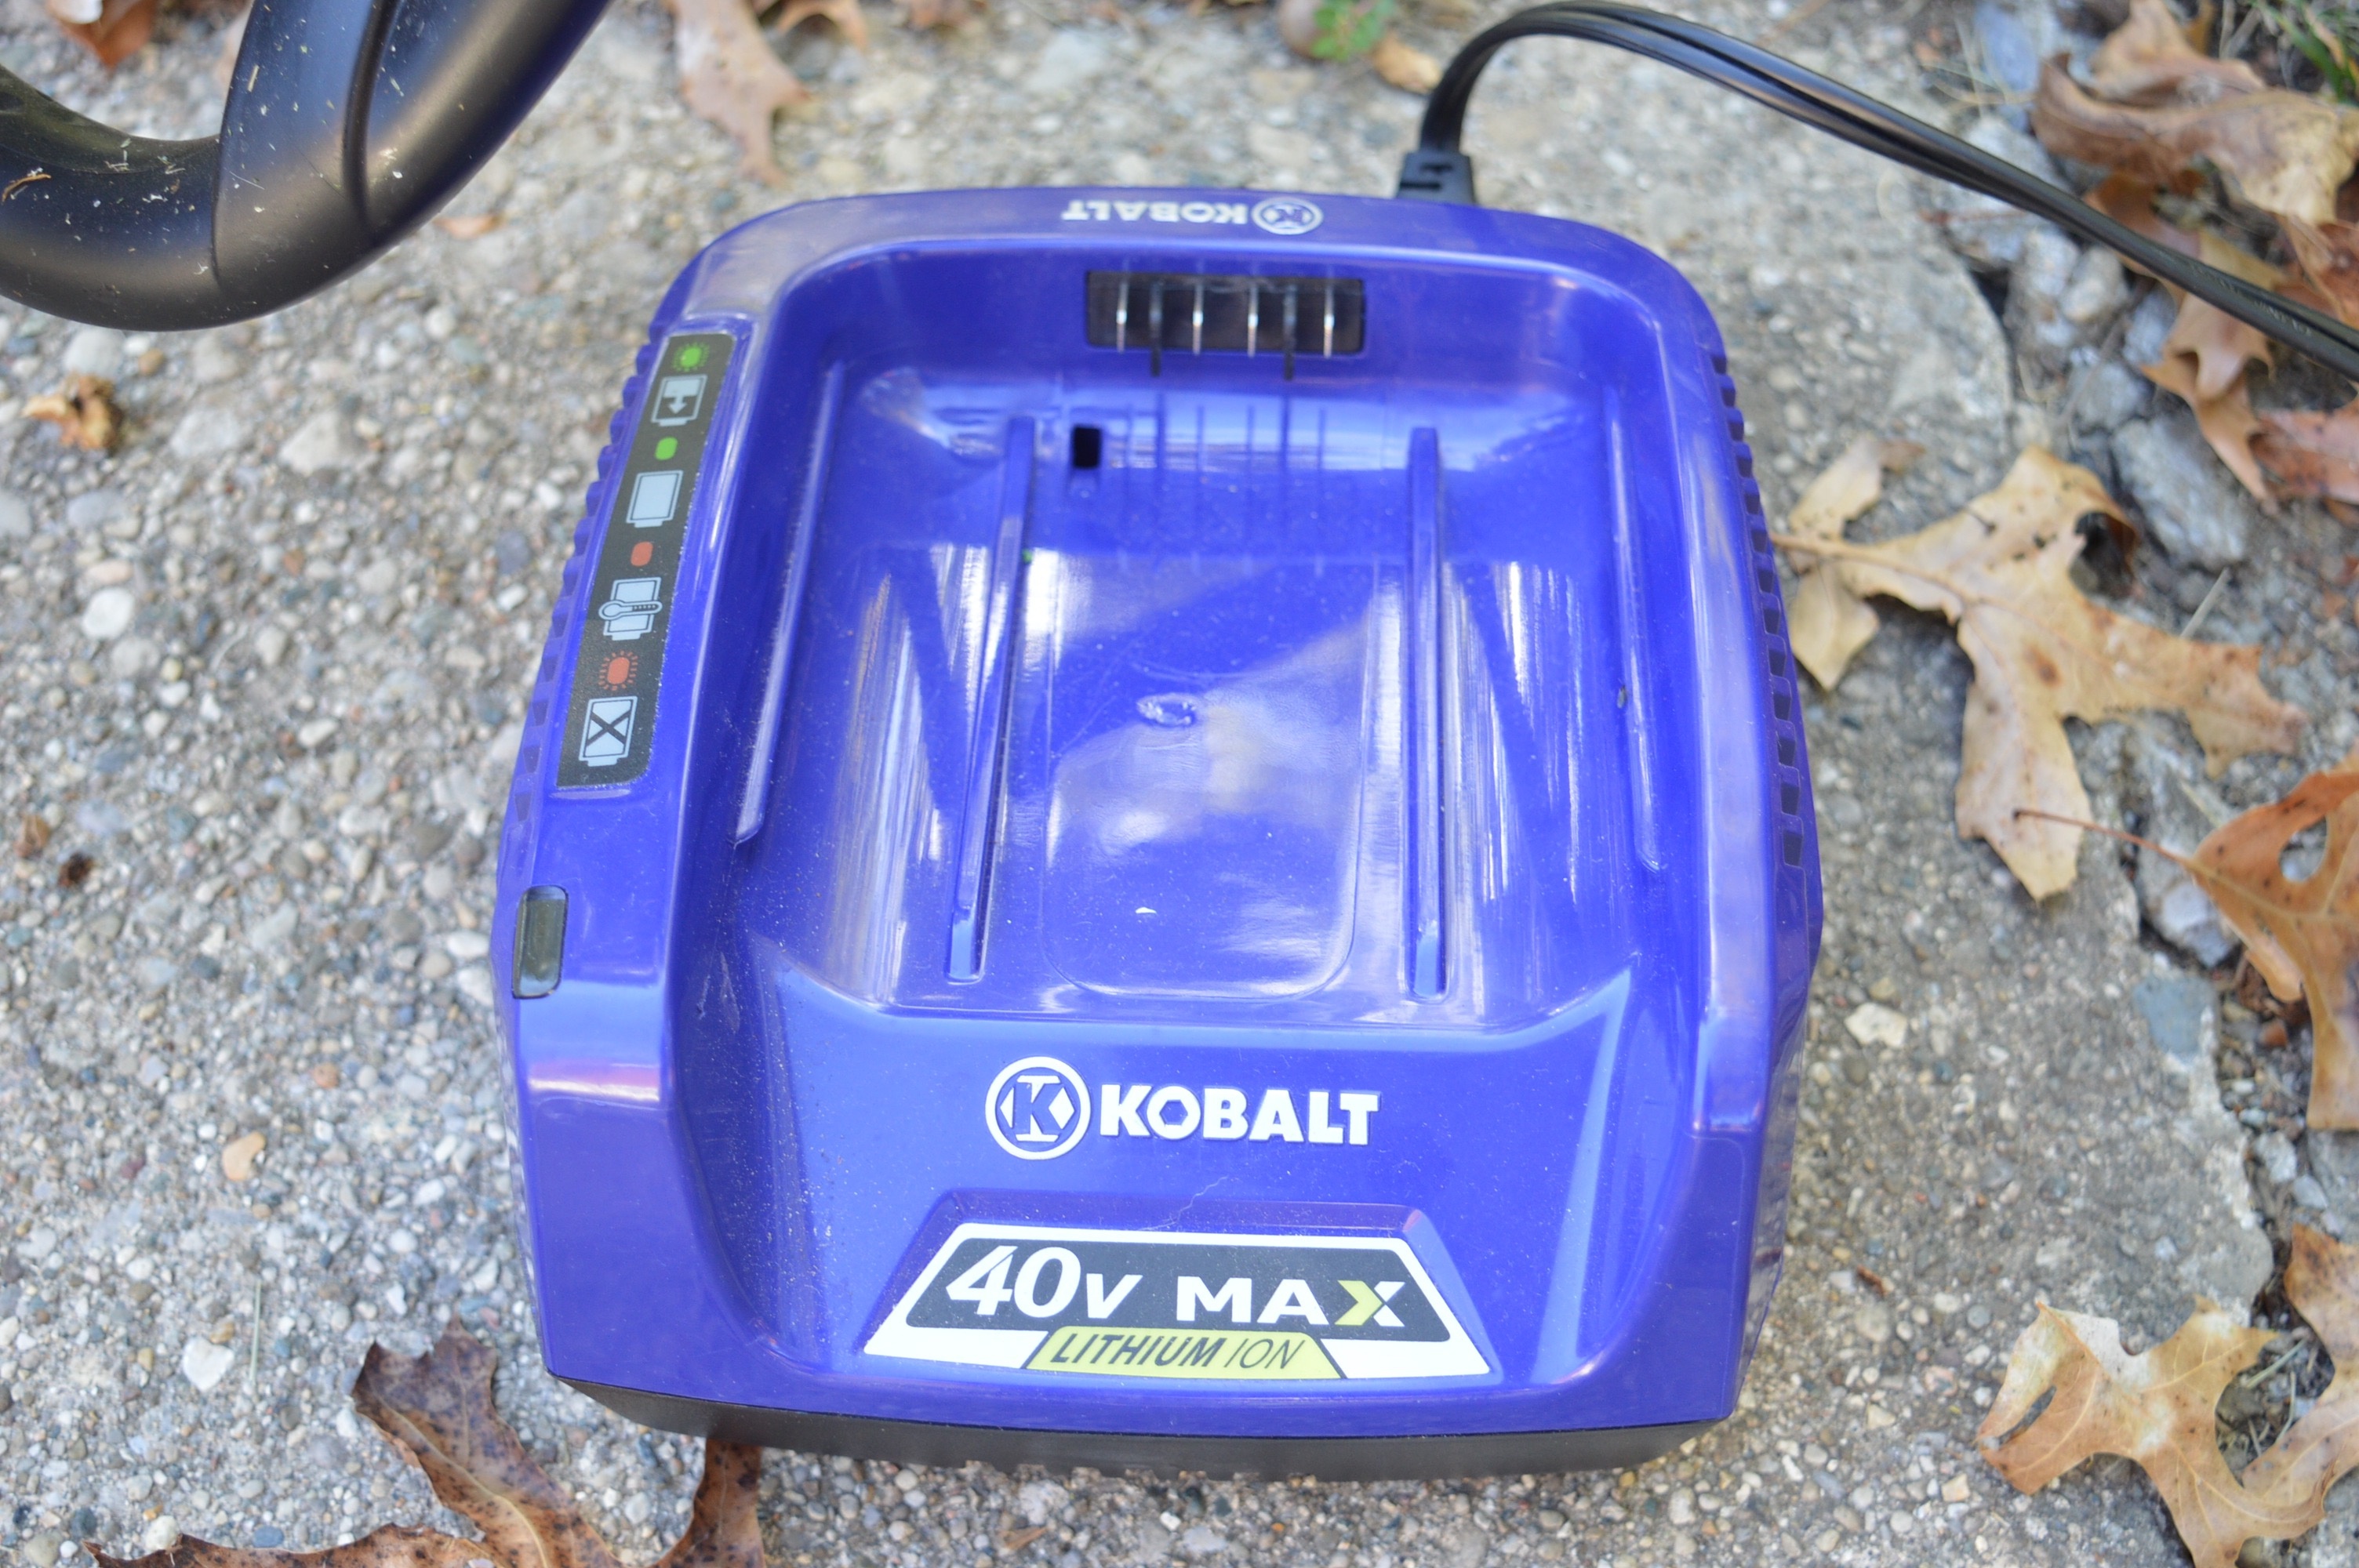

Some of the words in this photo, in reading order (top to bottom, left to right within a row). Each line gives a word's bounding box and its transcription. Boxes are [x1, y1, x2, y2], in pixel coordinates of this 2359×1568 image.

[1061, 199, 1248, 224] KOBALT
[1100, 1083, 1379, 1145] KOBALT
[1176, 1276, 1406, 1327] MAX
[1050, 1334, 1227, 1367] LITHIUM
[1223, 1338, 1306, 1370] ION
